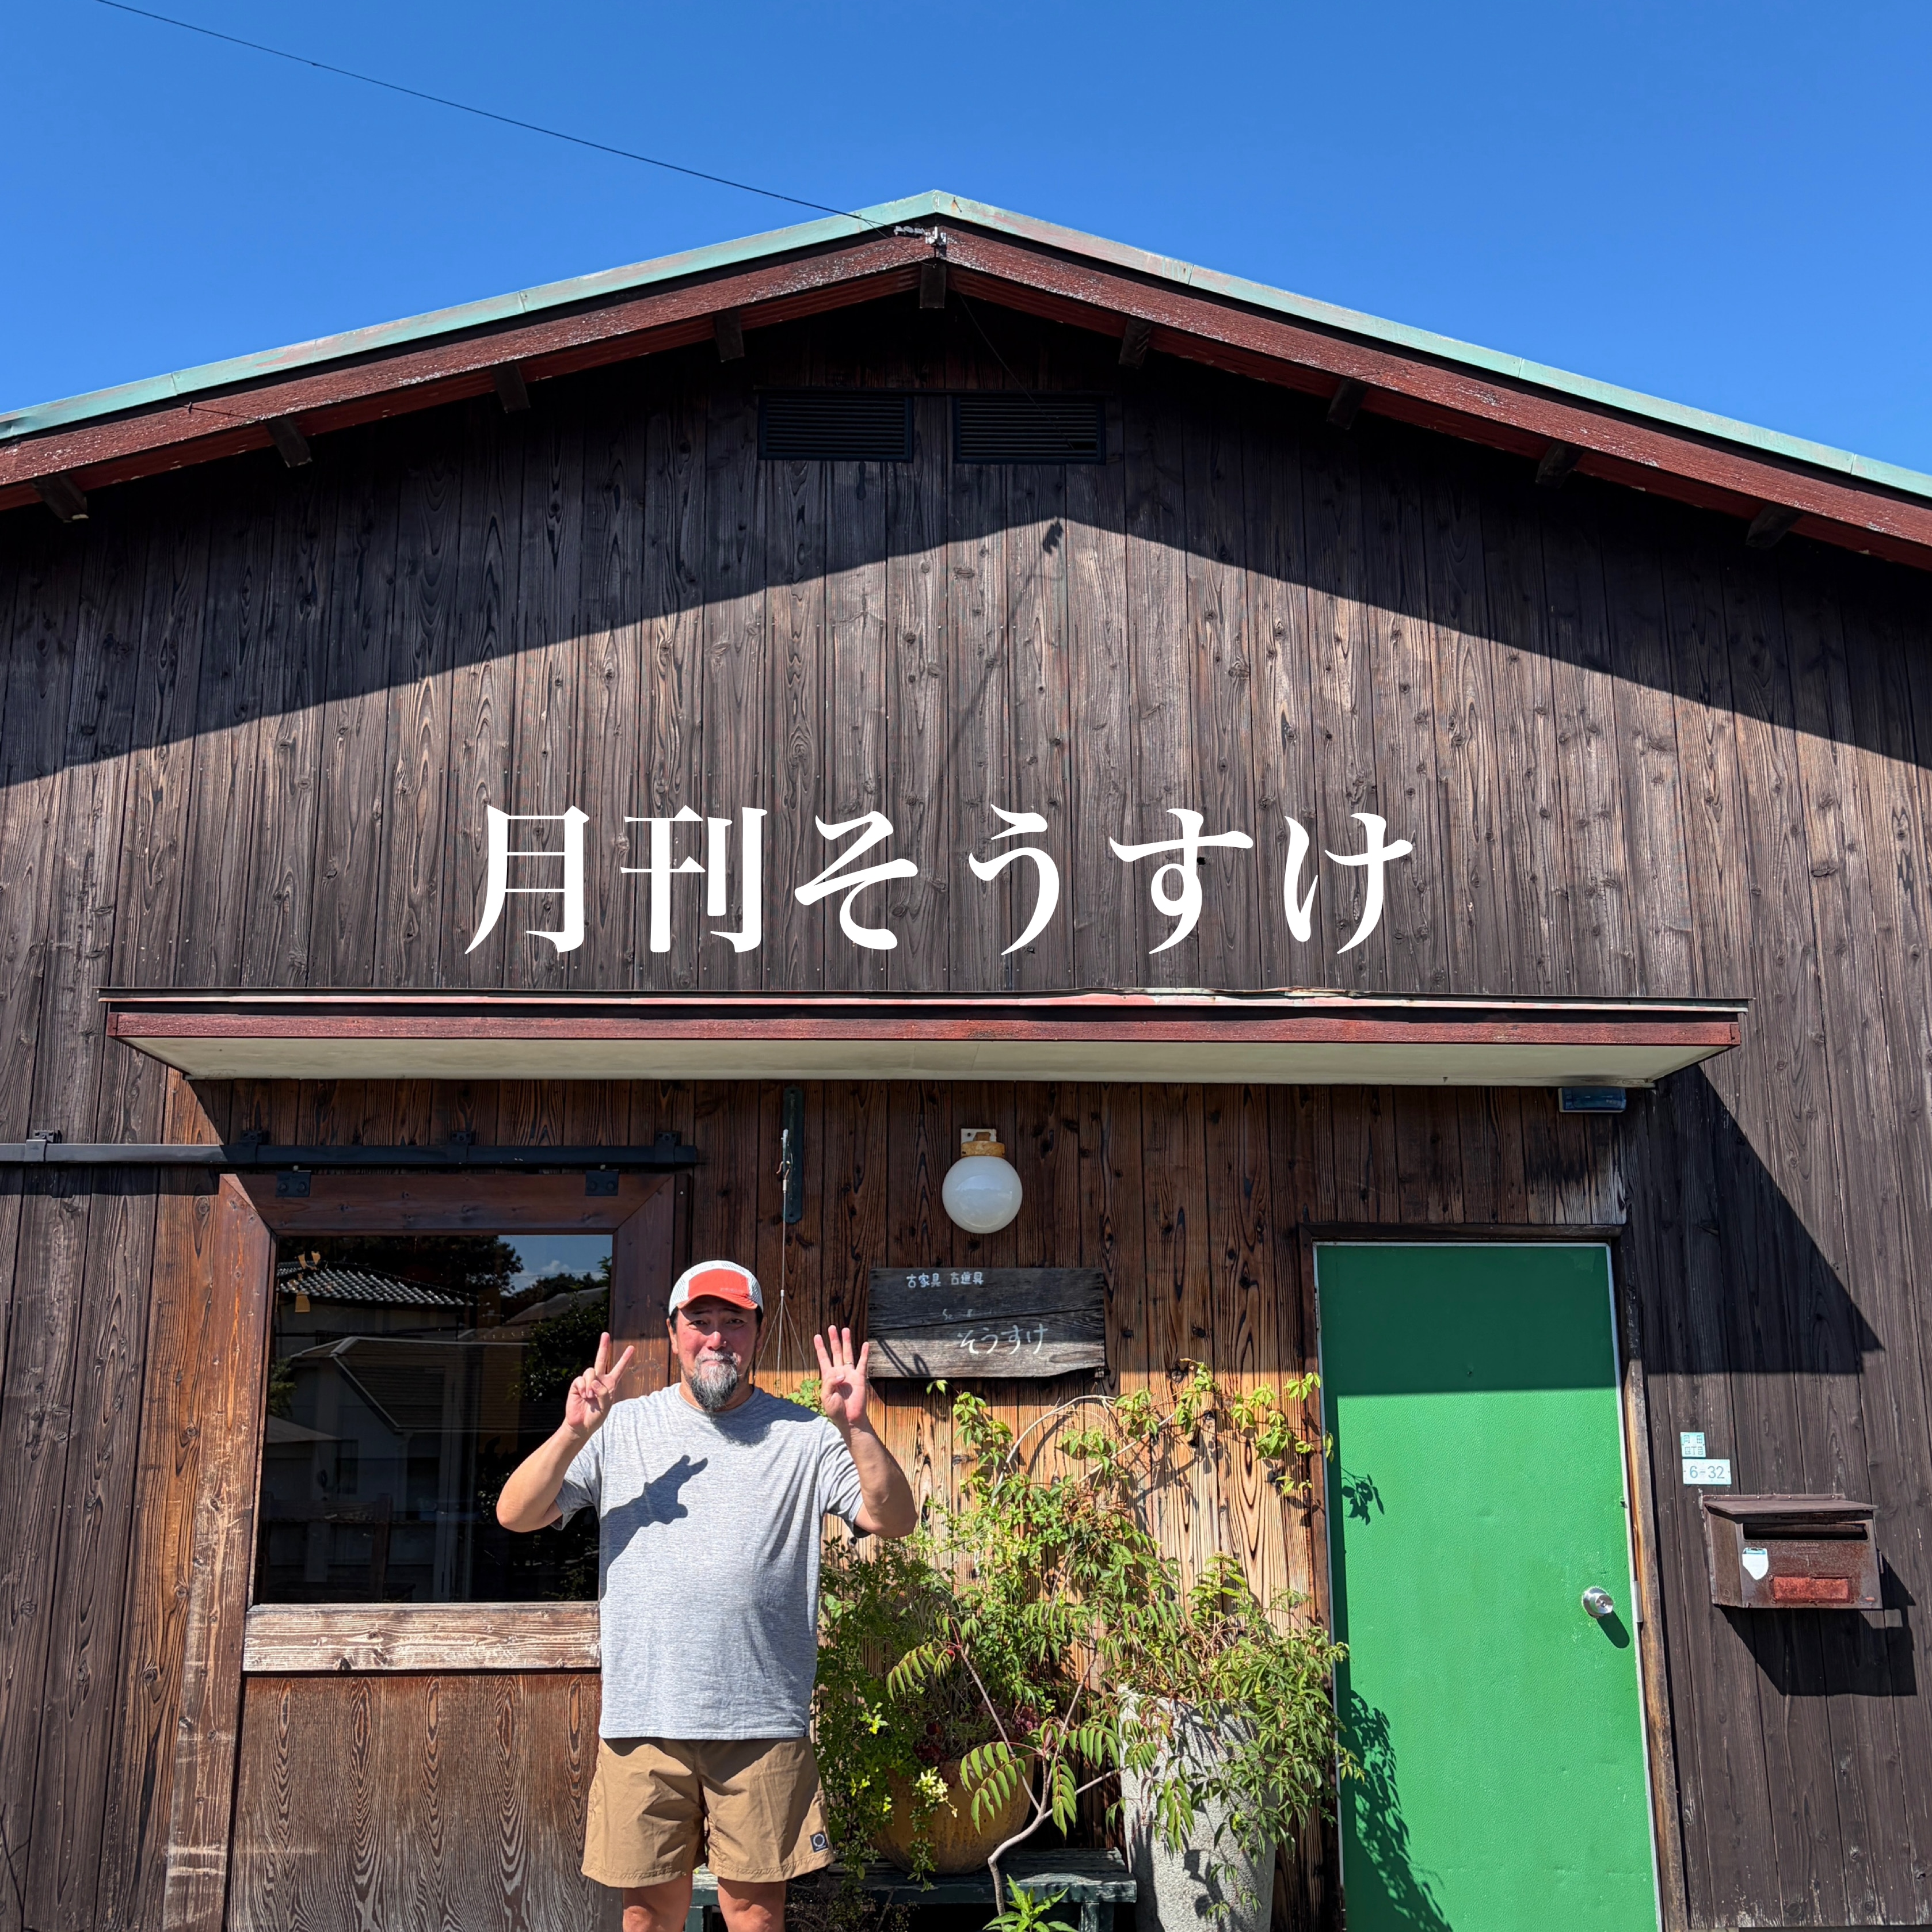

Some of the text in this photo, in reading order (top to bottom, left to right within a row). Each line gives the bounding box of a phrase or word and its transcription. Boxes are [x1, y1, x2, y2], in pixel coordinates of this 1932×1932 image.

[906, 1271, 984, 1288] 古家具 古道具
[957, 1323, 1049, 1355] そうすけ
[1690, 1465, 1725, 1479] 6-32
